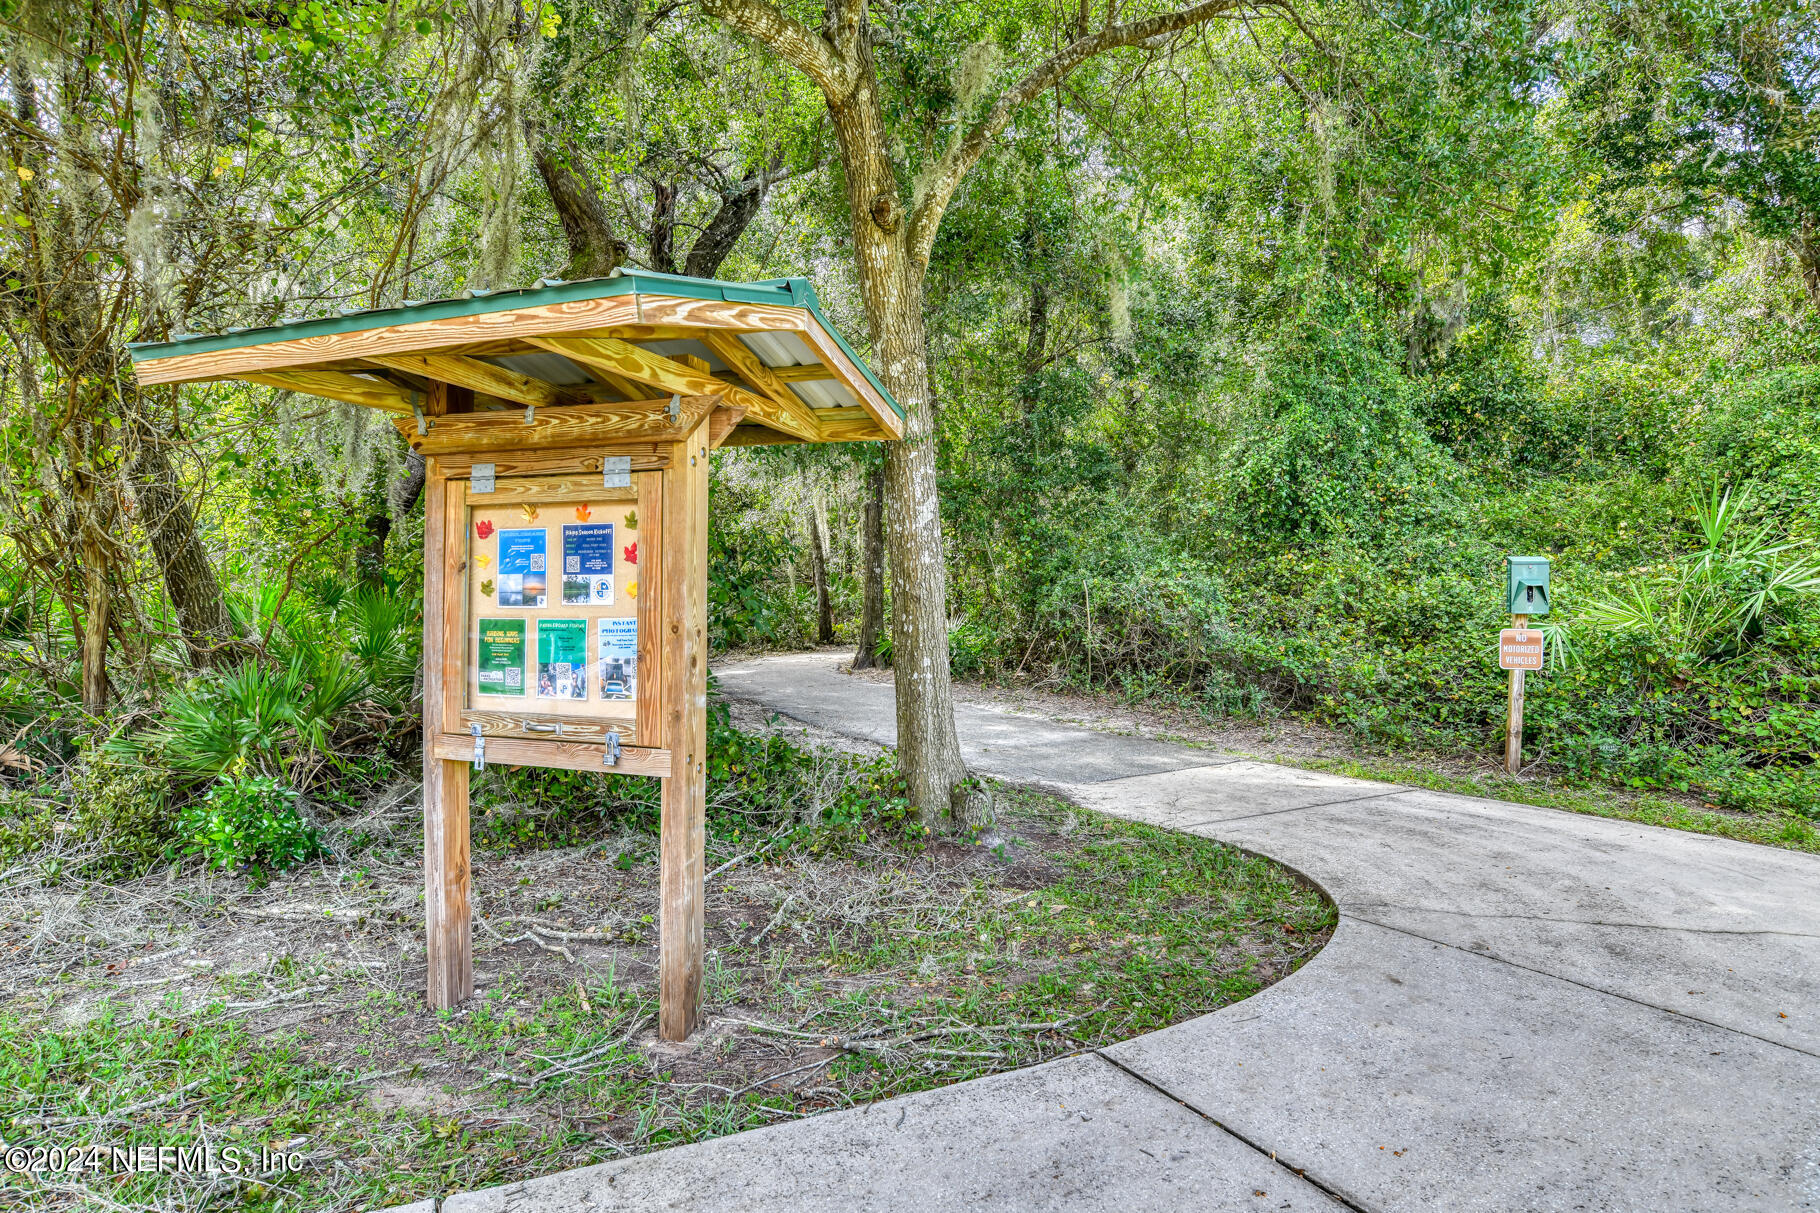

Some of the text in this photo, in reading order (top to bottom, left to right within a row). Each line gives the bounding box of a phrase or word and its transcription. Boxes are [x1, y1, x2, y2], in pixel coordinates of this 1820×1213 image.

[1516, 634, 1527, 642] NO
[1503, 645, 1539, 654] MOTORIZED
[1505, 656, 1537, 665] VEHICLES
